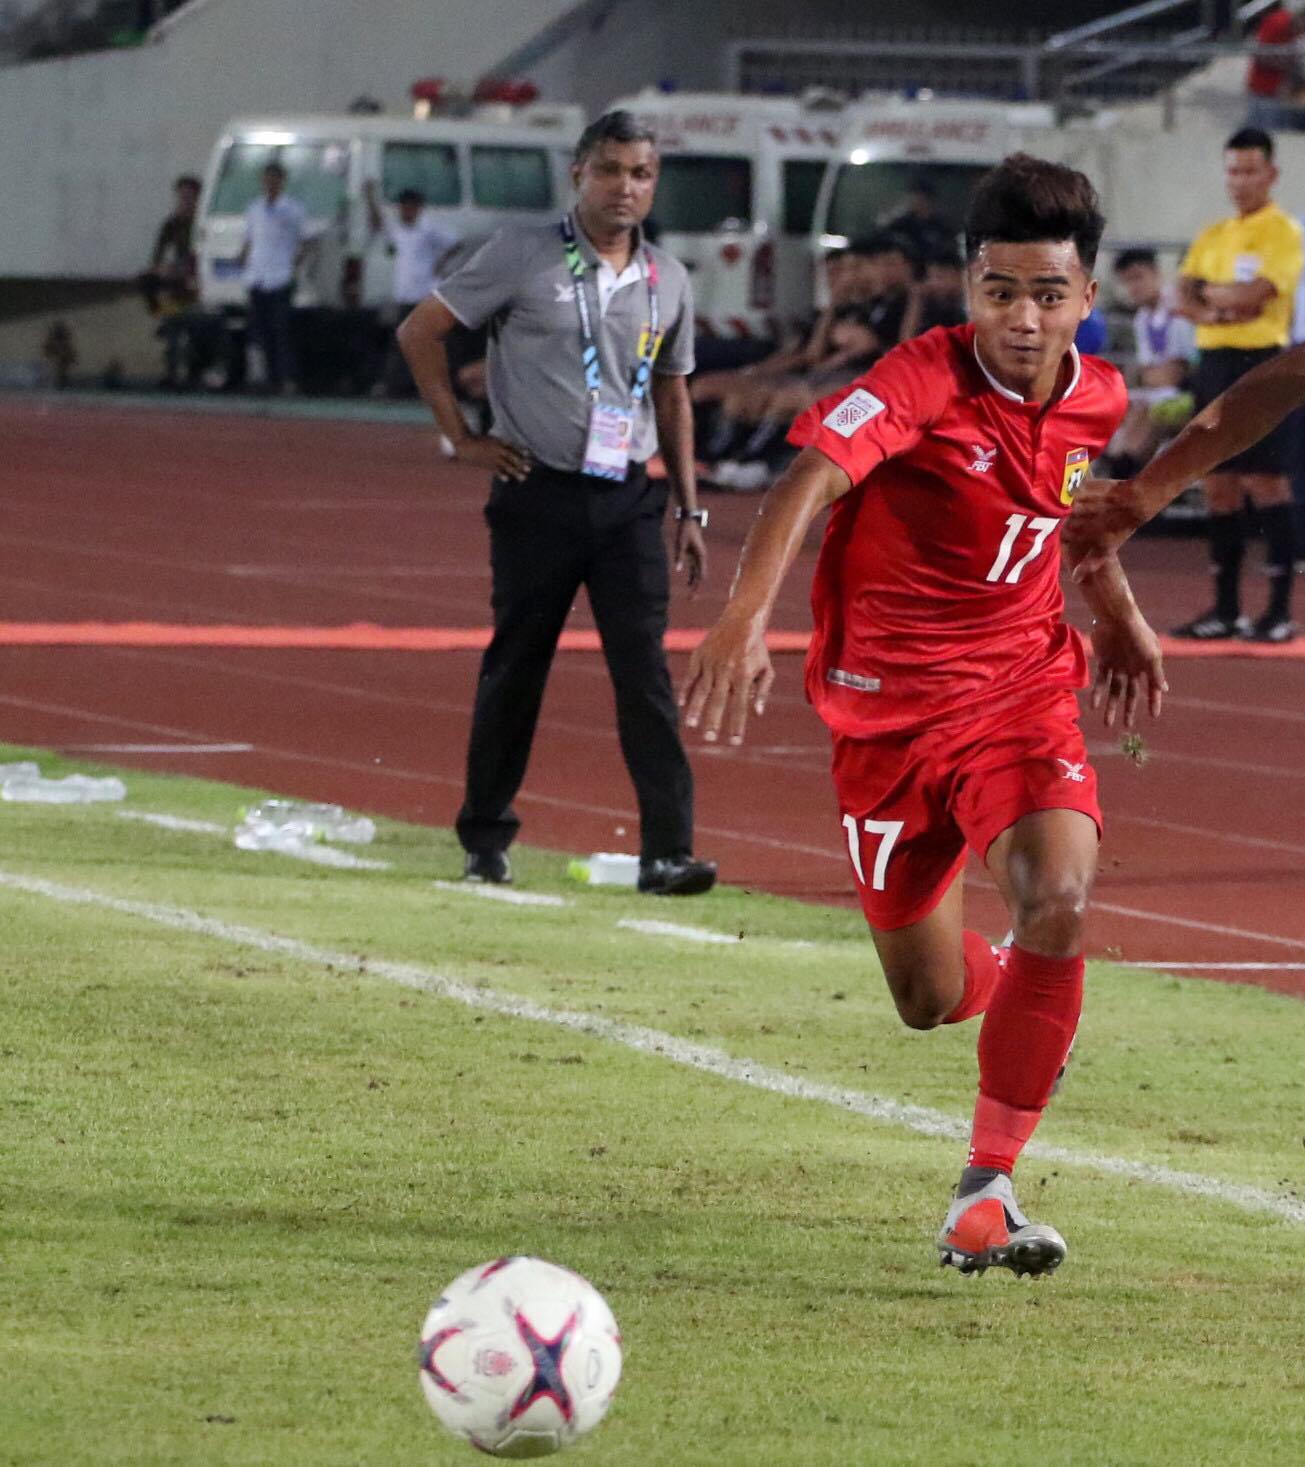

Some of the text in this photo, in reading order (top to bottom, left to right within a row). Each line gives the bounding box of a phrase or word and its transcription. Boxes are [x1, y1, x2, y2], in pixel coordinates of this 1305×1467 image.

[966, 460, 994, 473] FBT
[986, 513, 1060, 584] 17
[842, 813, 905, 891] 17
